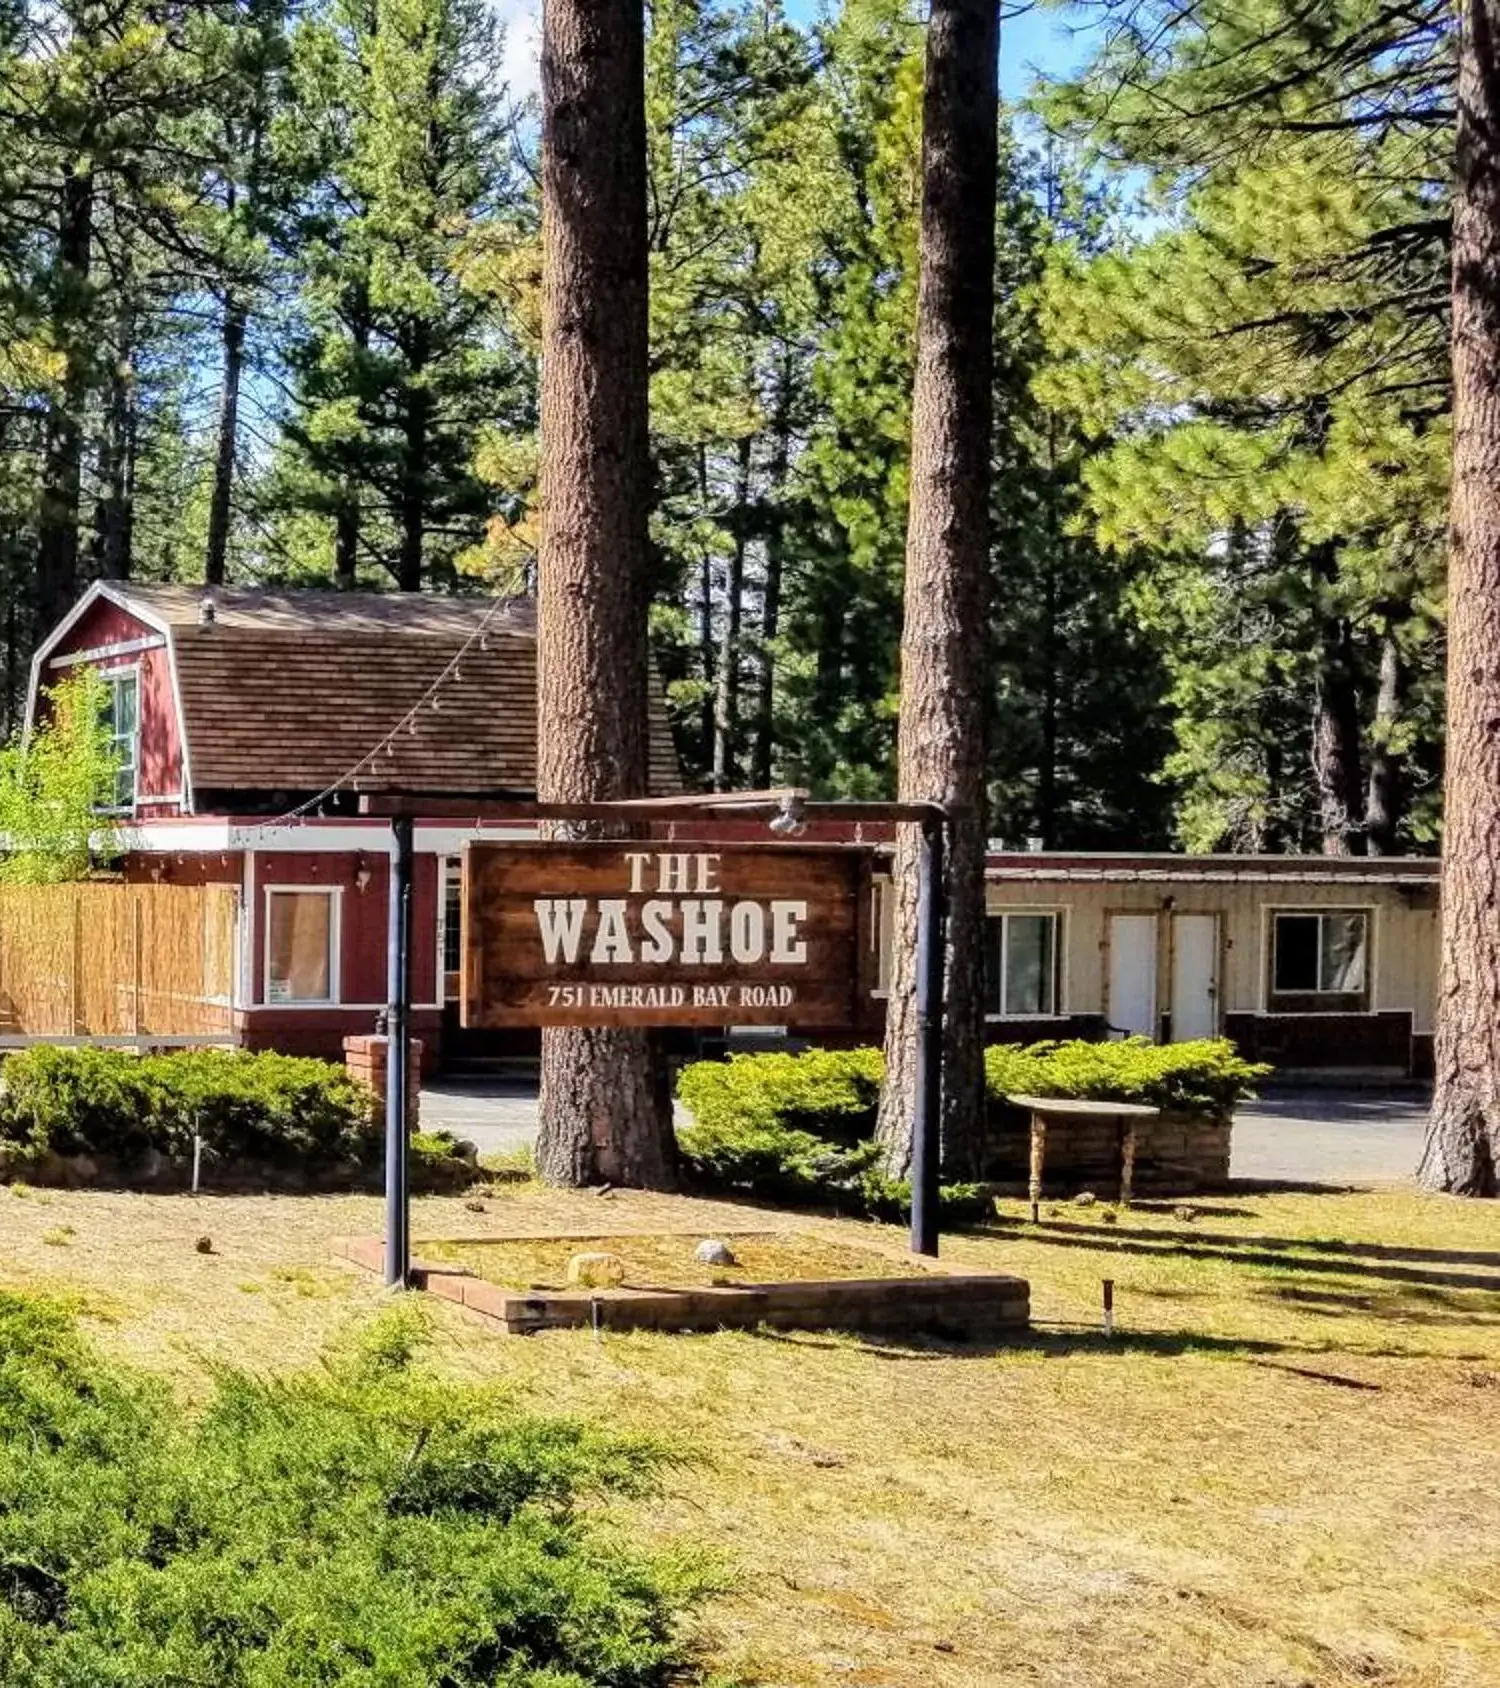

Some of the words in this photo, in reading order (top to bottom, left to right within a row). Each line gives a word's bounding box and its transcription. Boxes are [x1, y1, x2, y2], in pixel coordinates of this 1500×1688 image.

[624, 853, 722, 894] THE
[533, 899, 808, 964] WASHOE
[547, 986, 582, 1007] 751
[590, 986, 684, 1008] EMERALD
[692, 985, 731, 1007] BAY
[740, 985, 793, 1008] ROAD
